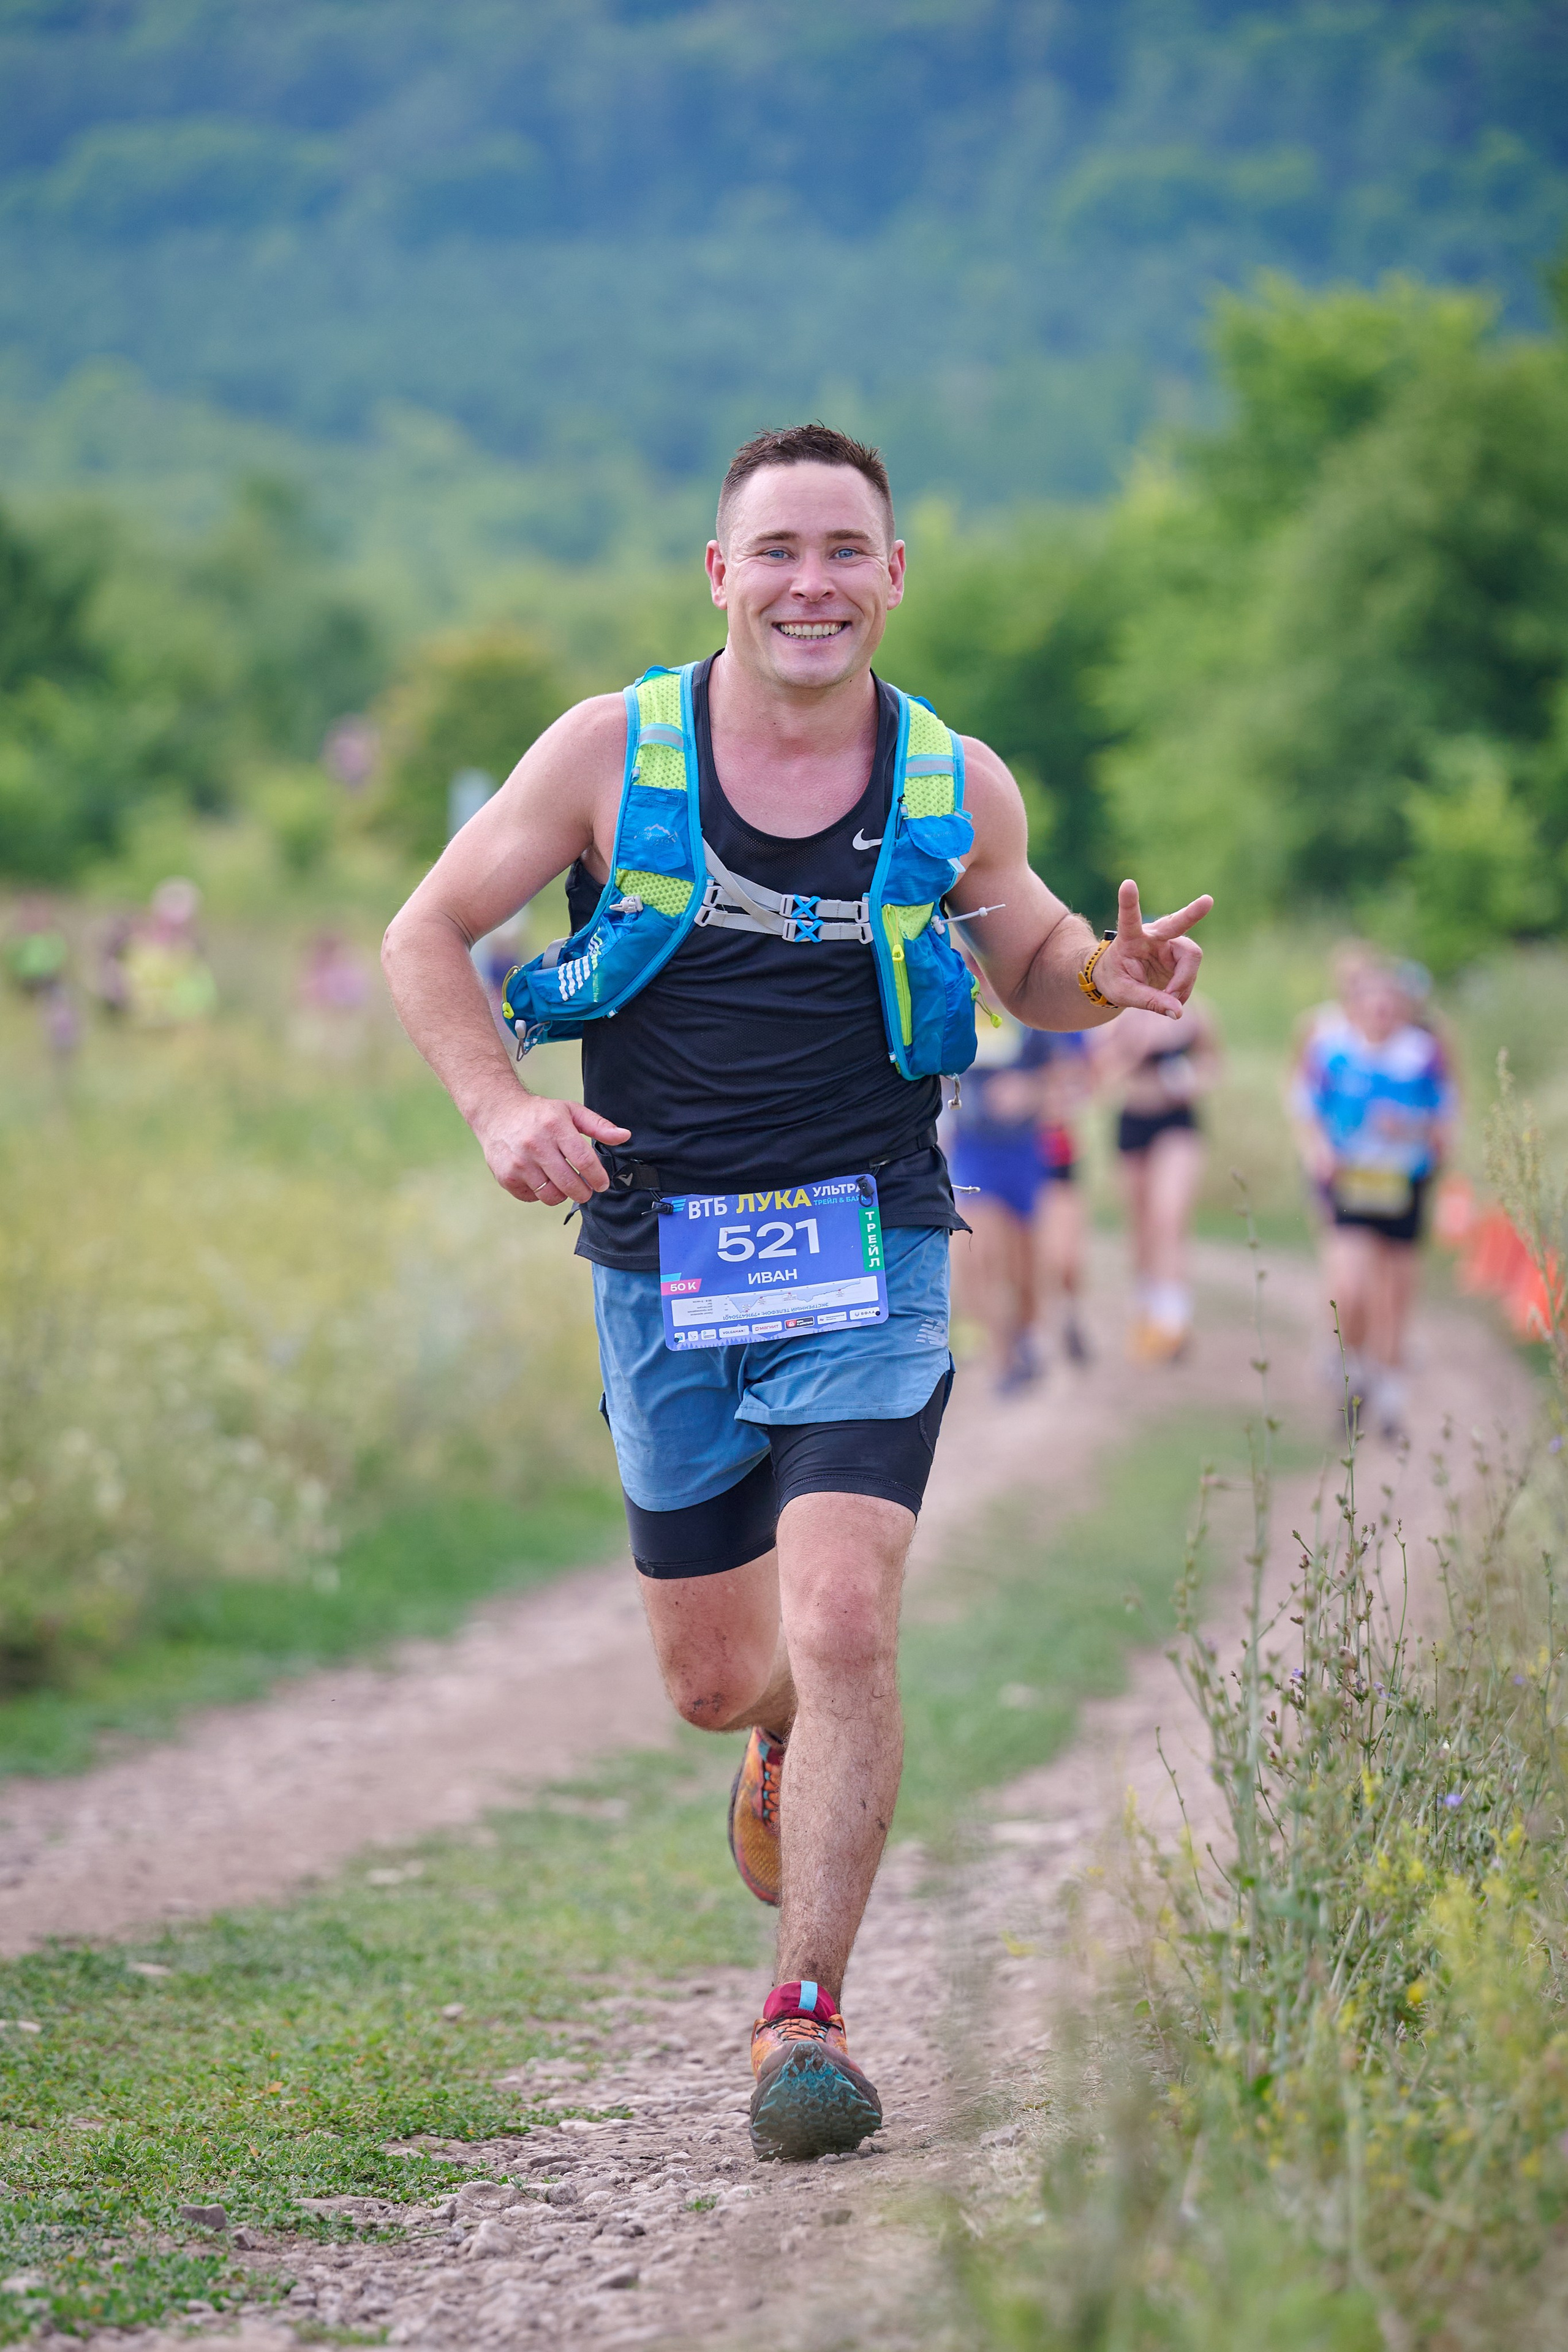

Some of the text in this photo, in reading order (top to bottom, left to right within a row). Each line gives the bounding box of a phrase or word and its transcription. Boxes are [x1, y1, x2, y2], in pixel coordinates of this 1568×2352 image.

[688, 1188, 812, 1219] ВТБ ЛУКА
[813, 1197, 837, 1205] ТРЕЙЛ
[717, 1218, 820, 1262] 521
[865, 1211, 880, 1267] ТРЕЙЛ
[748, 1268, 797, 1285] ИВАН
[670, 1283, 686, 1292] 50
[791, 1302, 829, 1313] ЭКСТРЕННЫЙ
